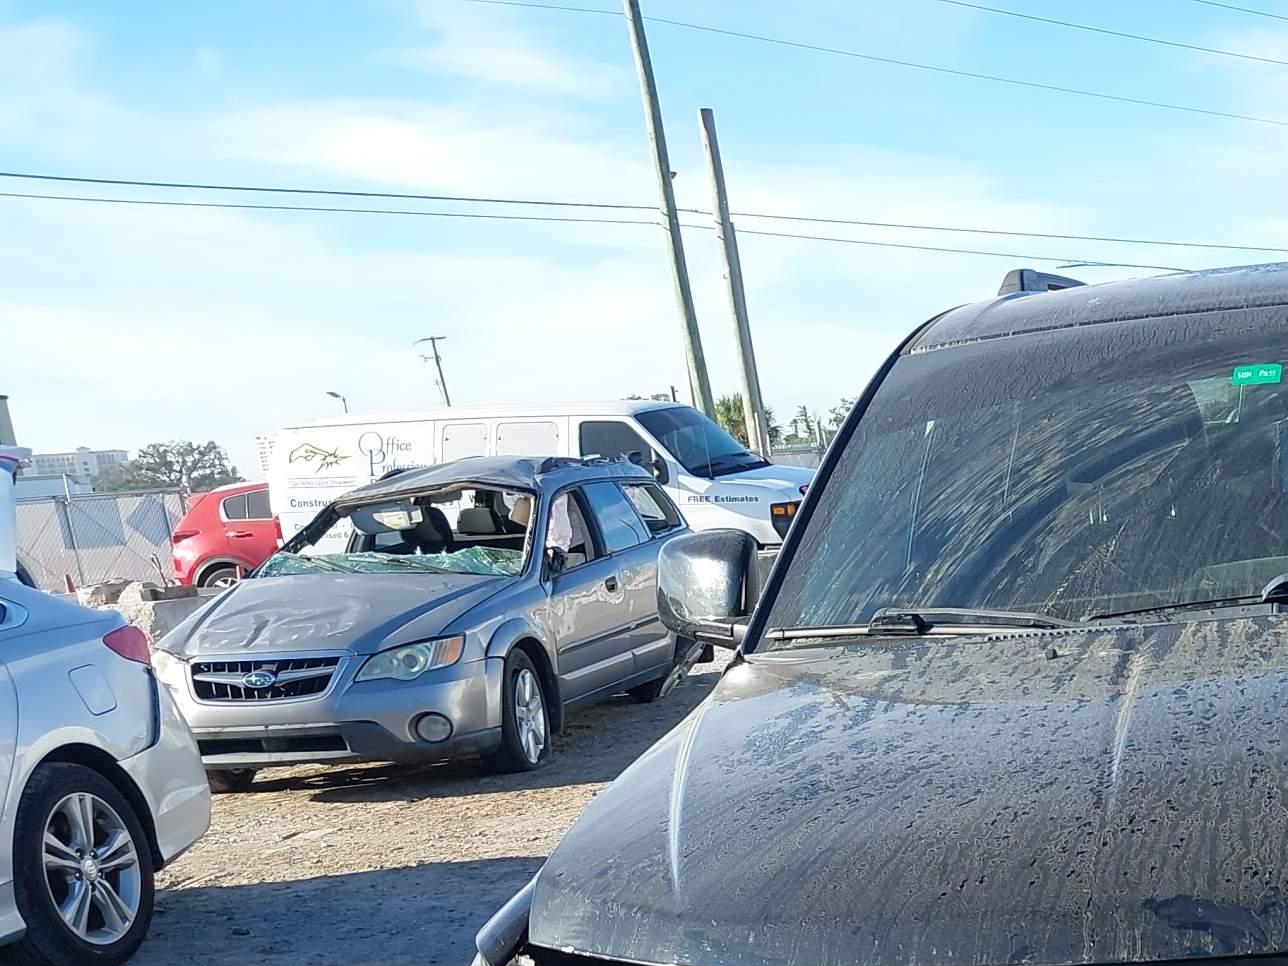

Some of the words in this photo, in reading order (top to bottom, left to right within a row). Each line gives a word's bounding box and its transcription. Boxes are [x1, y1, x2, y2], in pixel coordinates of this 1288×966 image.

[1258, 369, 1276, 377] PASS
[358, 431, 412, 457] Office
[687, 495, 712, 503] FREE
[714, 495, 760, 503] Estimates
